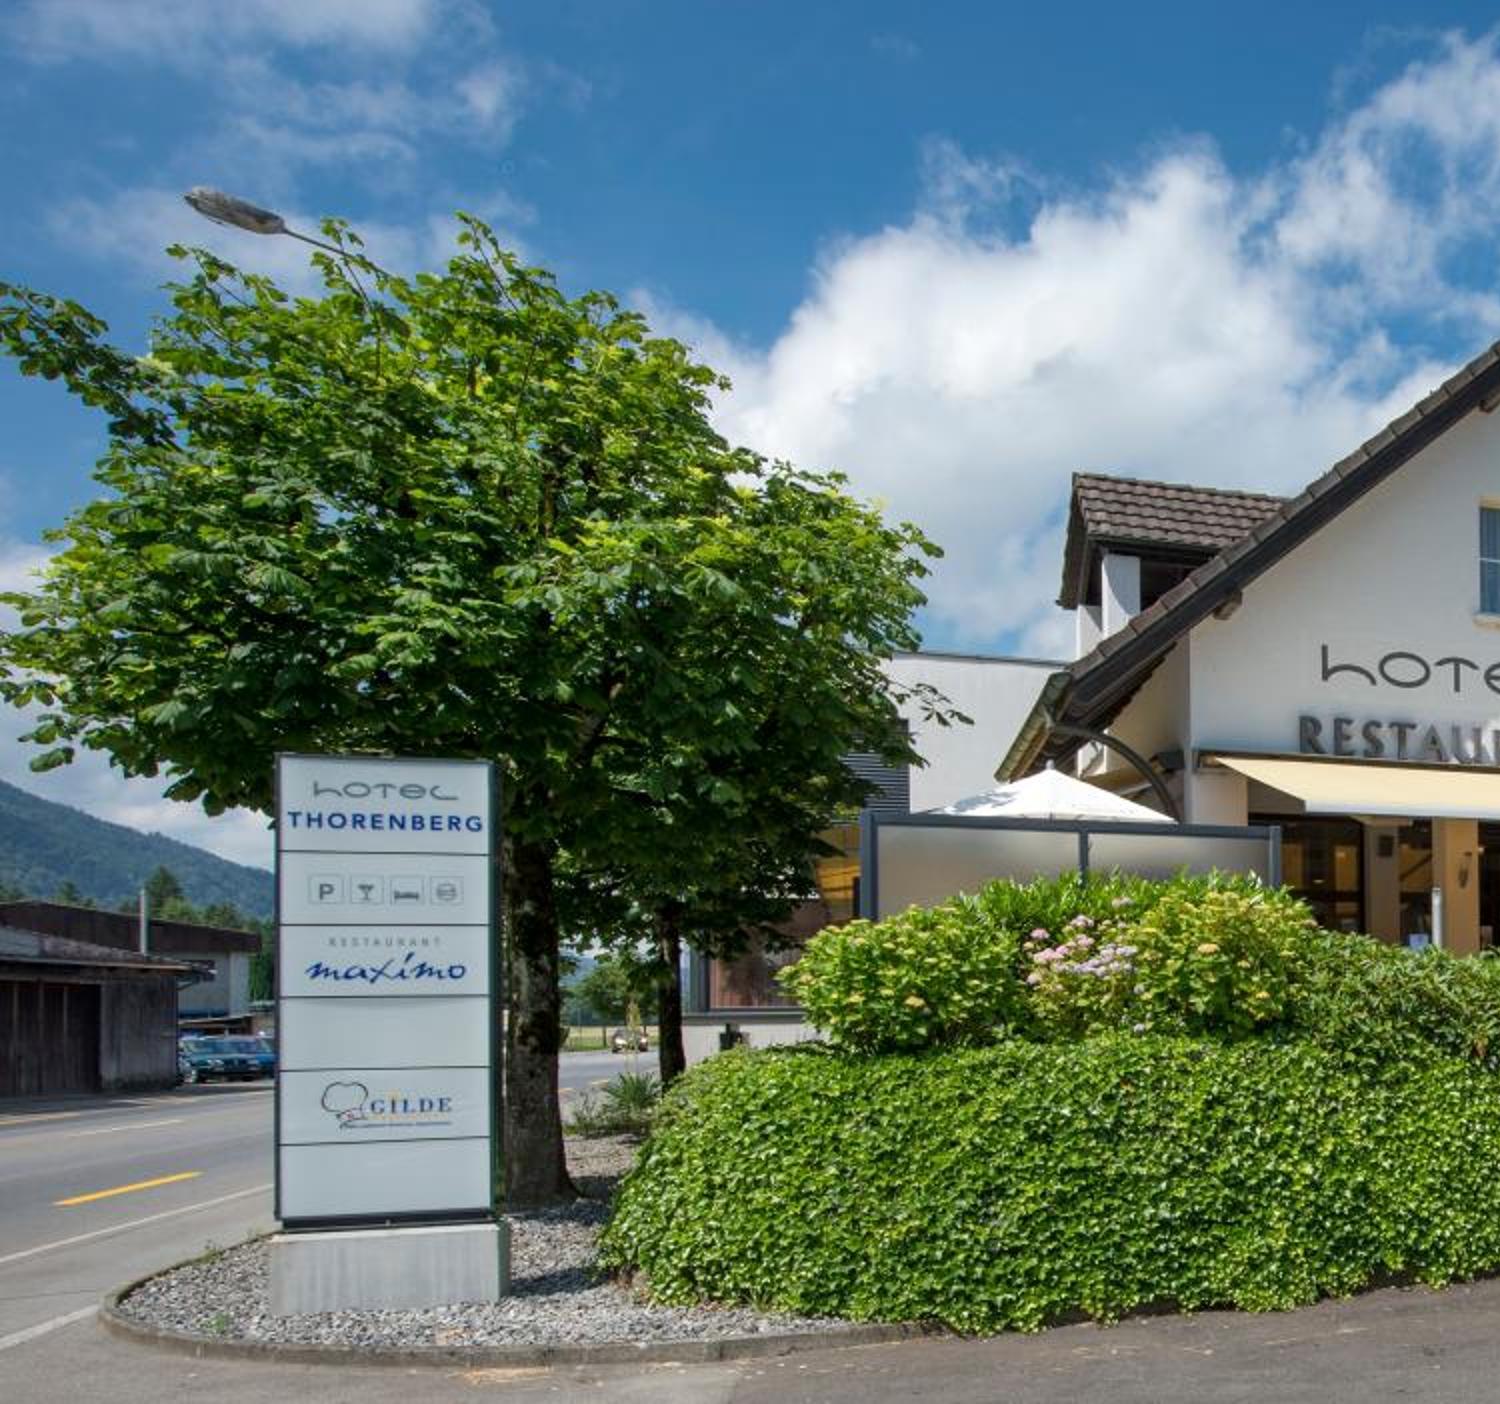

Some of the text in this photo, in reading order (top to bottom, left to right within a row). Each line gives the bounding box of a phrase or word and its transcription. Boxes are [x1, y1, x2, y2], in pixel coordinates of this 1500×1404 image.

[287, 811, 483, 832] THORENBERG
[328, 936, 441, 947] RESTAURANT
[370, 1097, 453, 1115] GILDE
